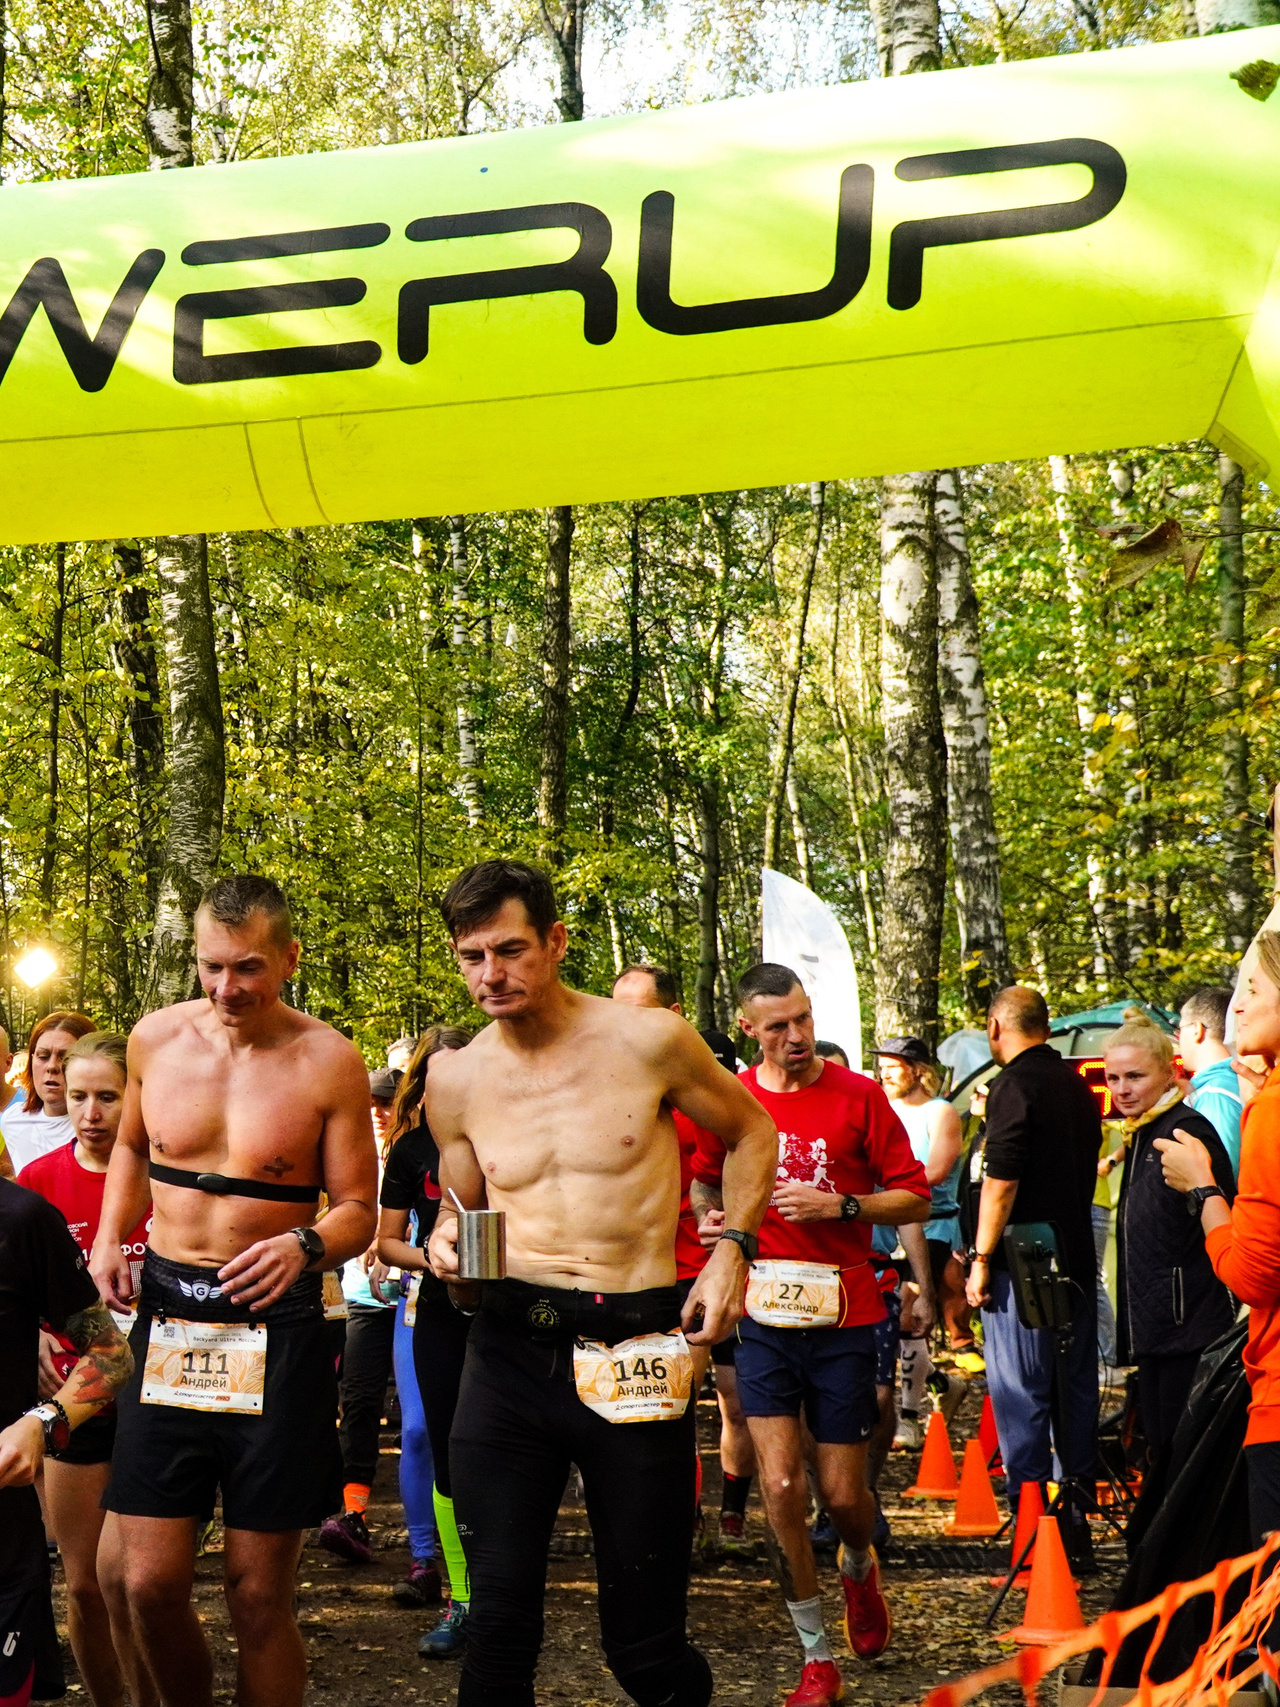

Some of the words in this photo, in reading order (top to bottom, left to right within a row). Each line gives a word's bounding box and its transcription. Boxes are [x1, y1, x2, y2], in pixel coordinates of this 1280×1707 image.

[778, 1283, 804, 1300] 27
[762, 1300, 819, 1314] Александр
[182, 1351, 229, 1375] 111
[613, 1357, 667, 1382] 146
[179, 1374, 227, 1390] Андрей
[617, 1382, 668, 1397] Андрей
